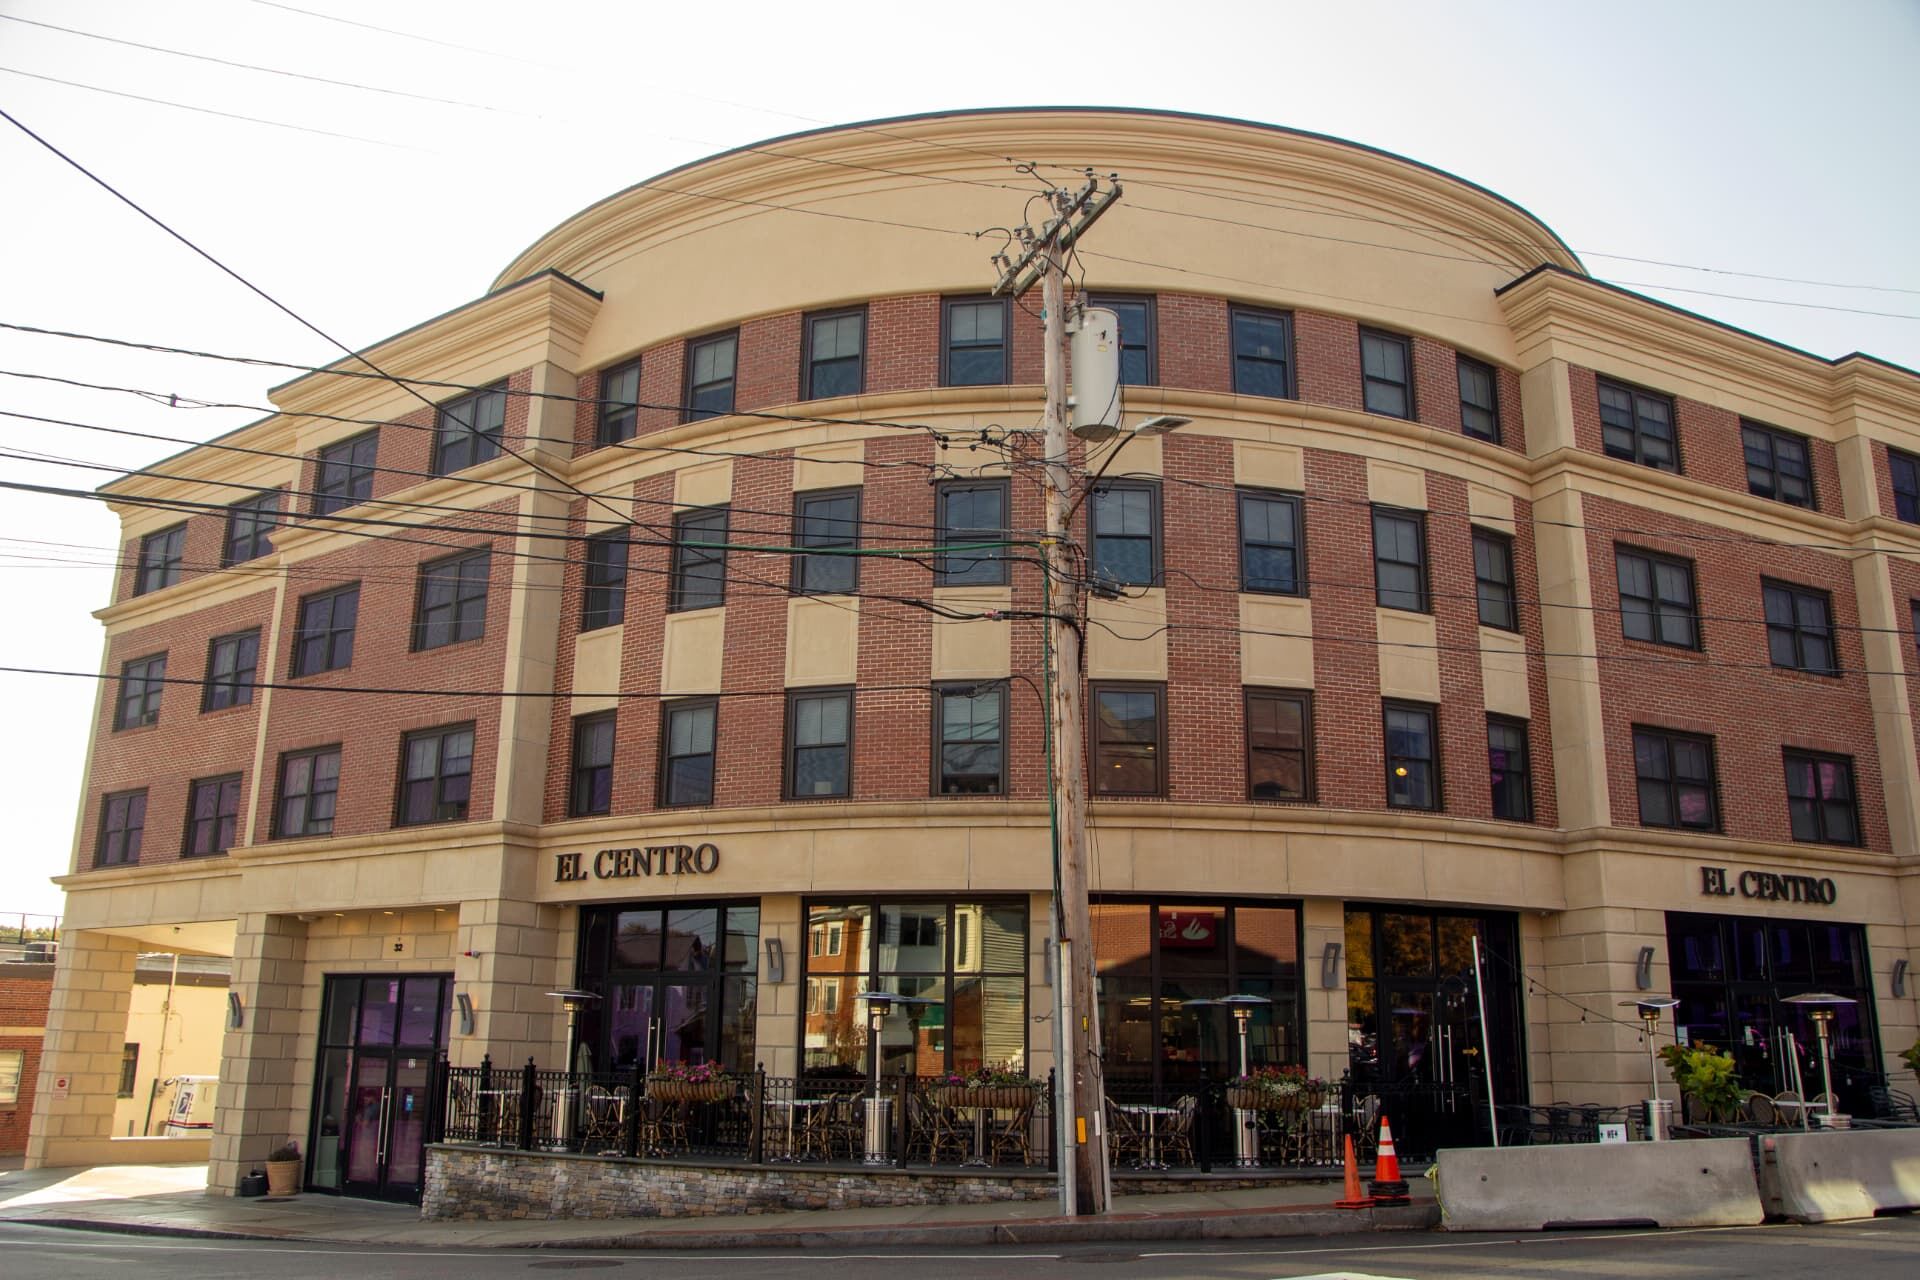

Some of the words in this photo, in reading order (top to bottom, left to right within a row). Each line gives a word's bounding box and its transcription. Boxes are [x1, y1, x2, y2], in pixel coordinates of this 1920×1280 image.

[555, 853, 587, 882] EL
[594, 843, 719, 879] CENTRO
[1700, 866, 1735, 896] EL
[1739, 871, 1836, 905] CENTRO
